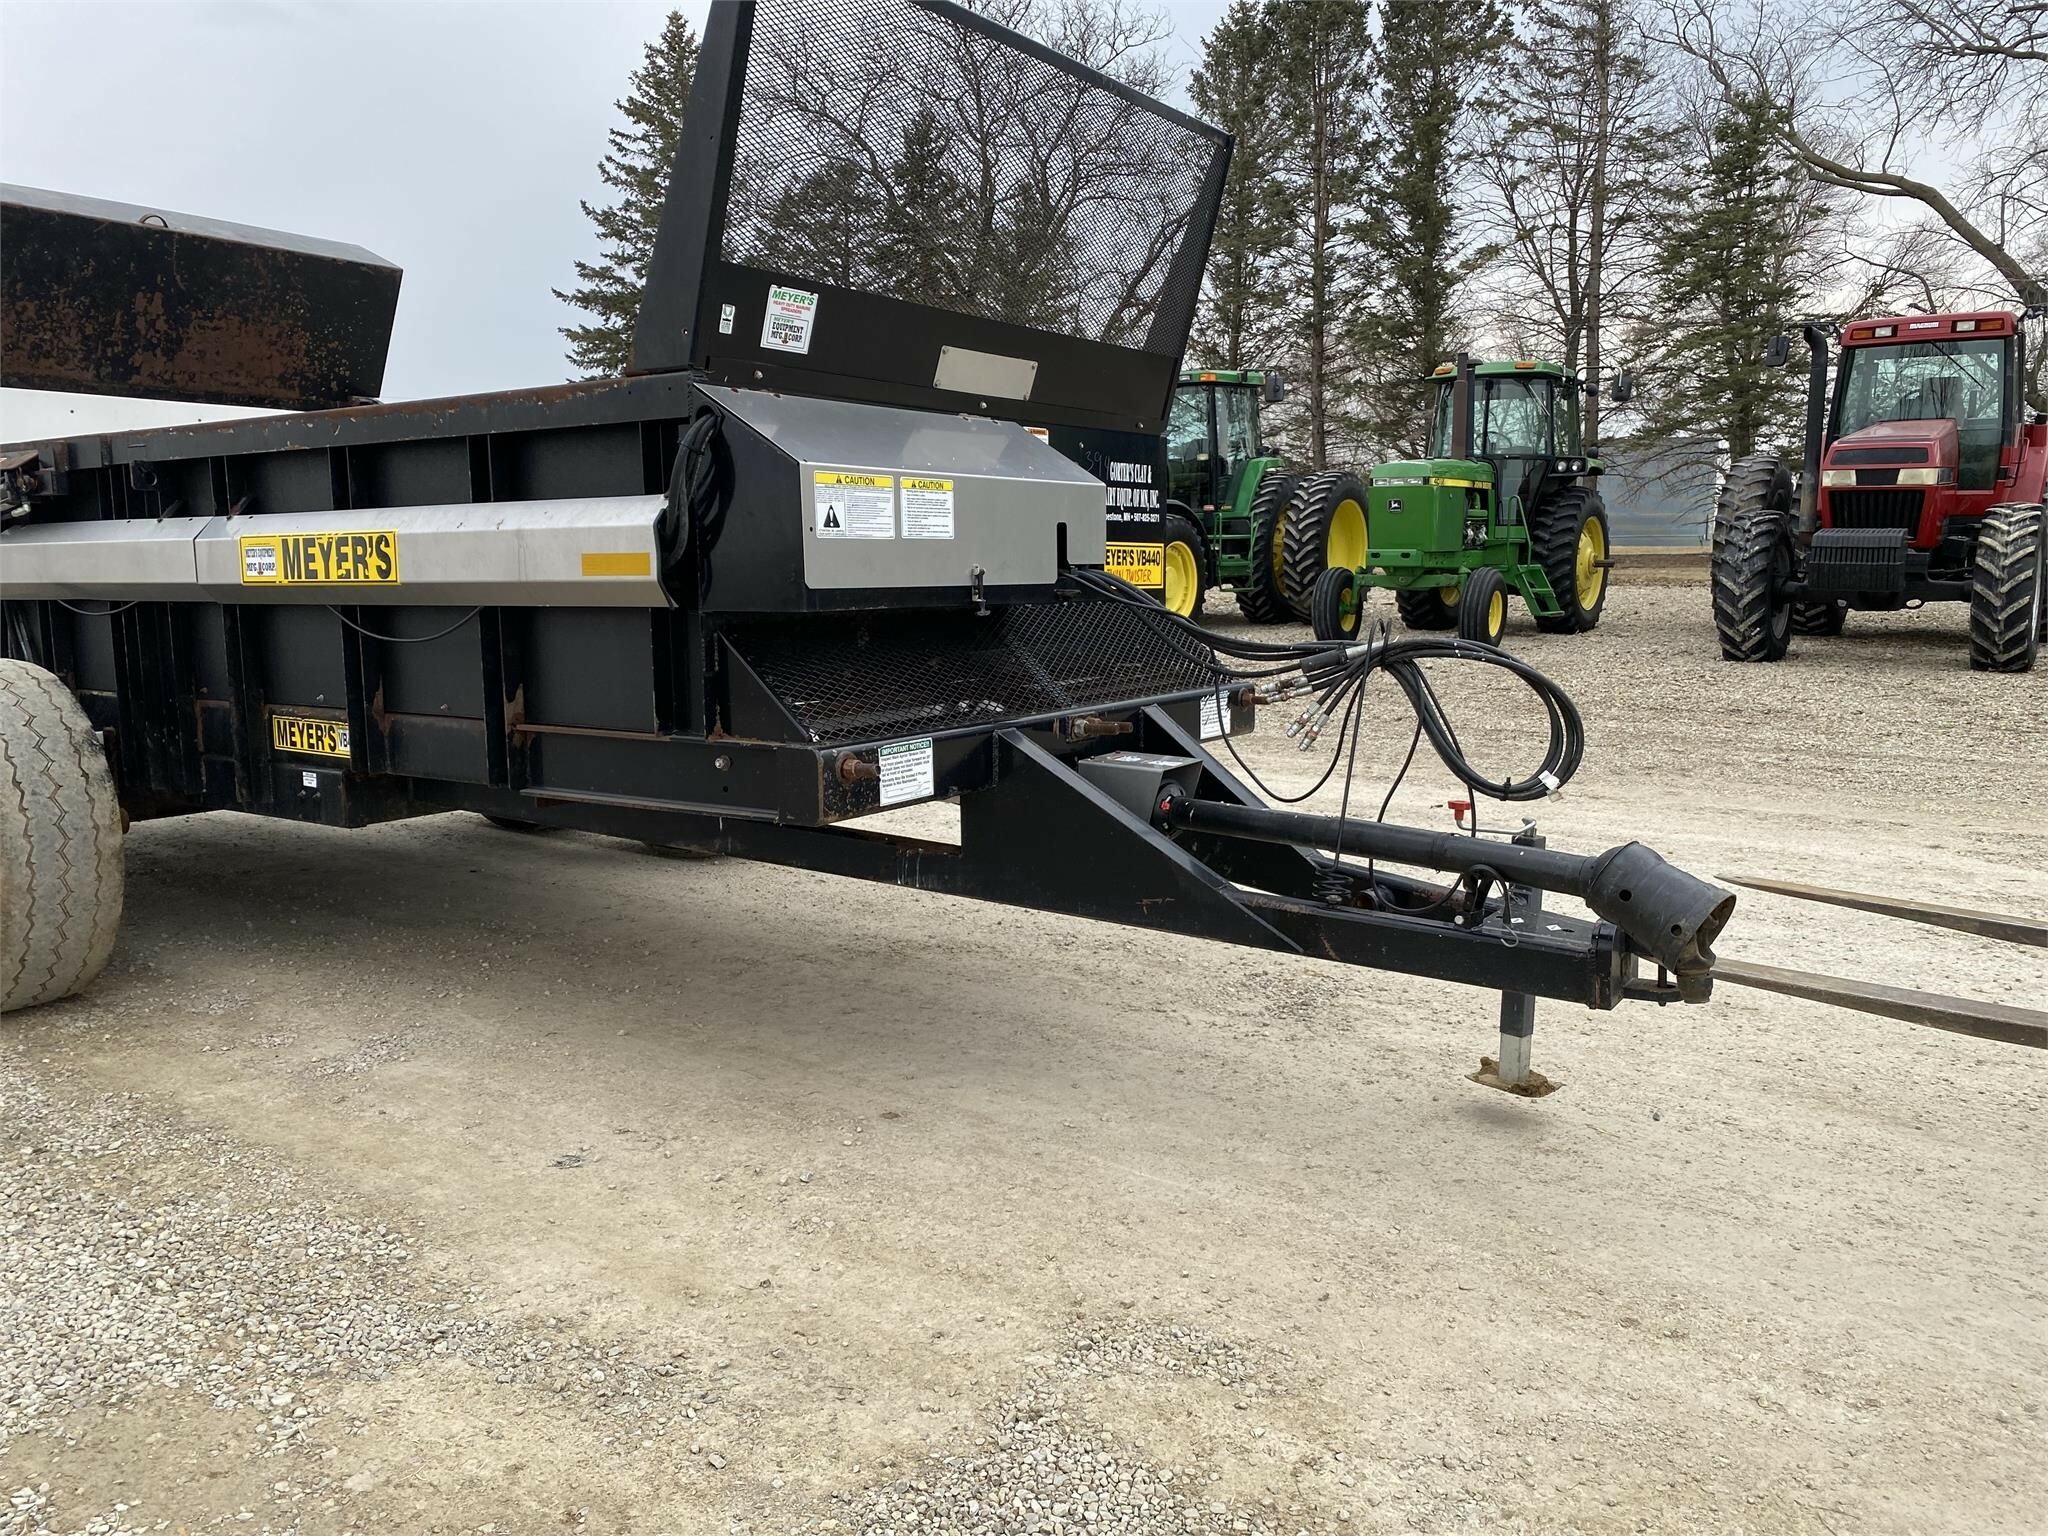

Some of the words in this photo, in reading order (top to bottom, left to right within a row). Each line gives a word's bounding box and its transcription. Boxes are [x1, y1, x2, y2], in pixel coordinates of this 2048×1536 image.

[771, 289, 815, 306] MEYER'S
[771, 322, 804, 334] EQUIPMENT
[1110, 461, 1134, 483] GORTER'S
[844, 475, 875, 486] CAUTION
[917, 480, 944, 490] CAUTION
[281, 534, 392, 580] MEYER'S
[1105, 548, 1135, 567] EYER'S
[1136, 549, 1161, 567] VB440
[1125, 568, 1152, 584] TWISTER
[276, 719, 337, 752] MEYER'S
[338, 731, 349, 748] VB
[881, 745, 909, 756] IMPORTANT
